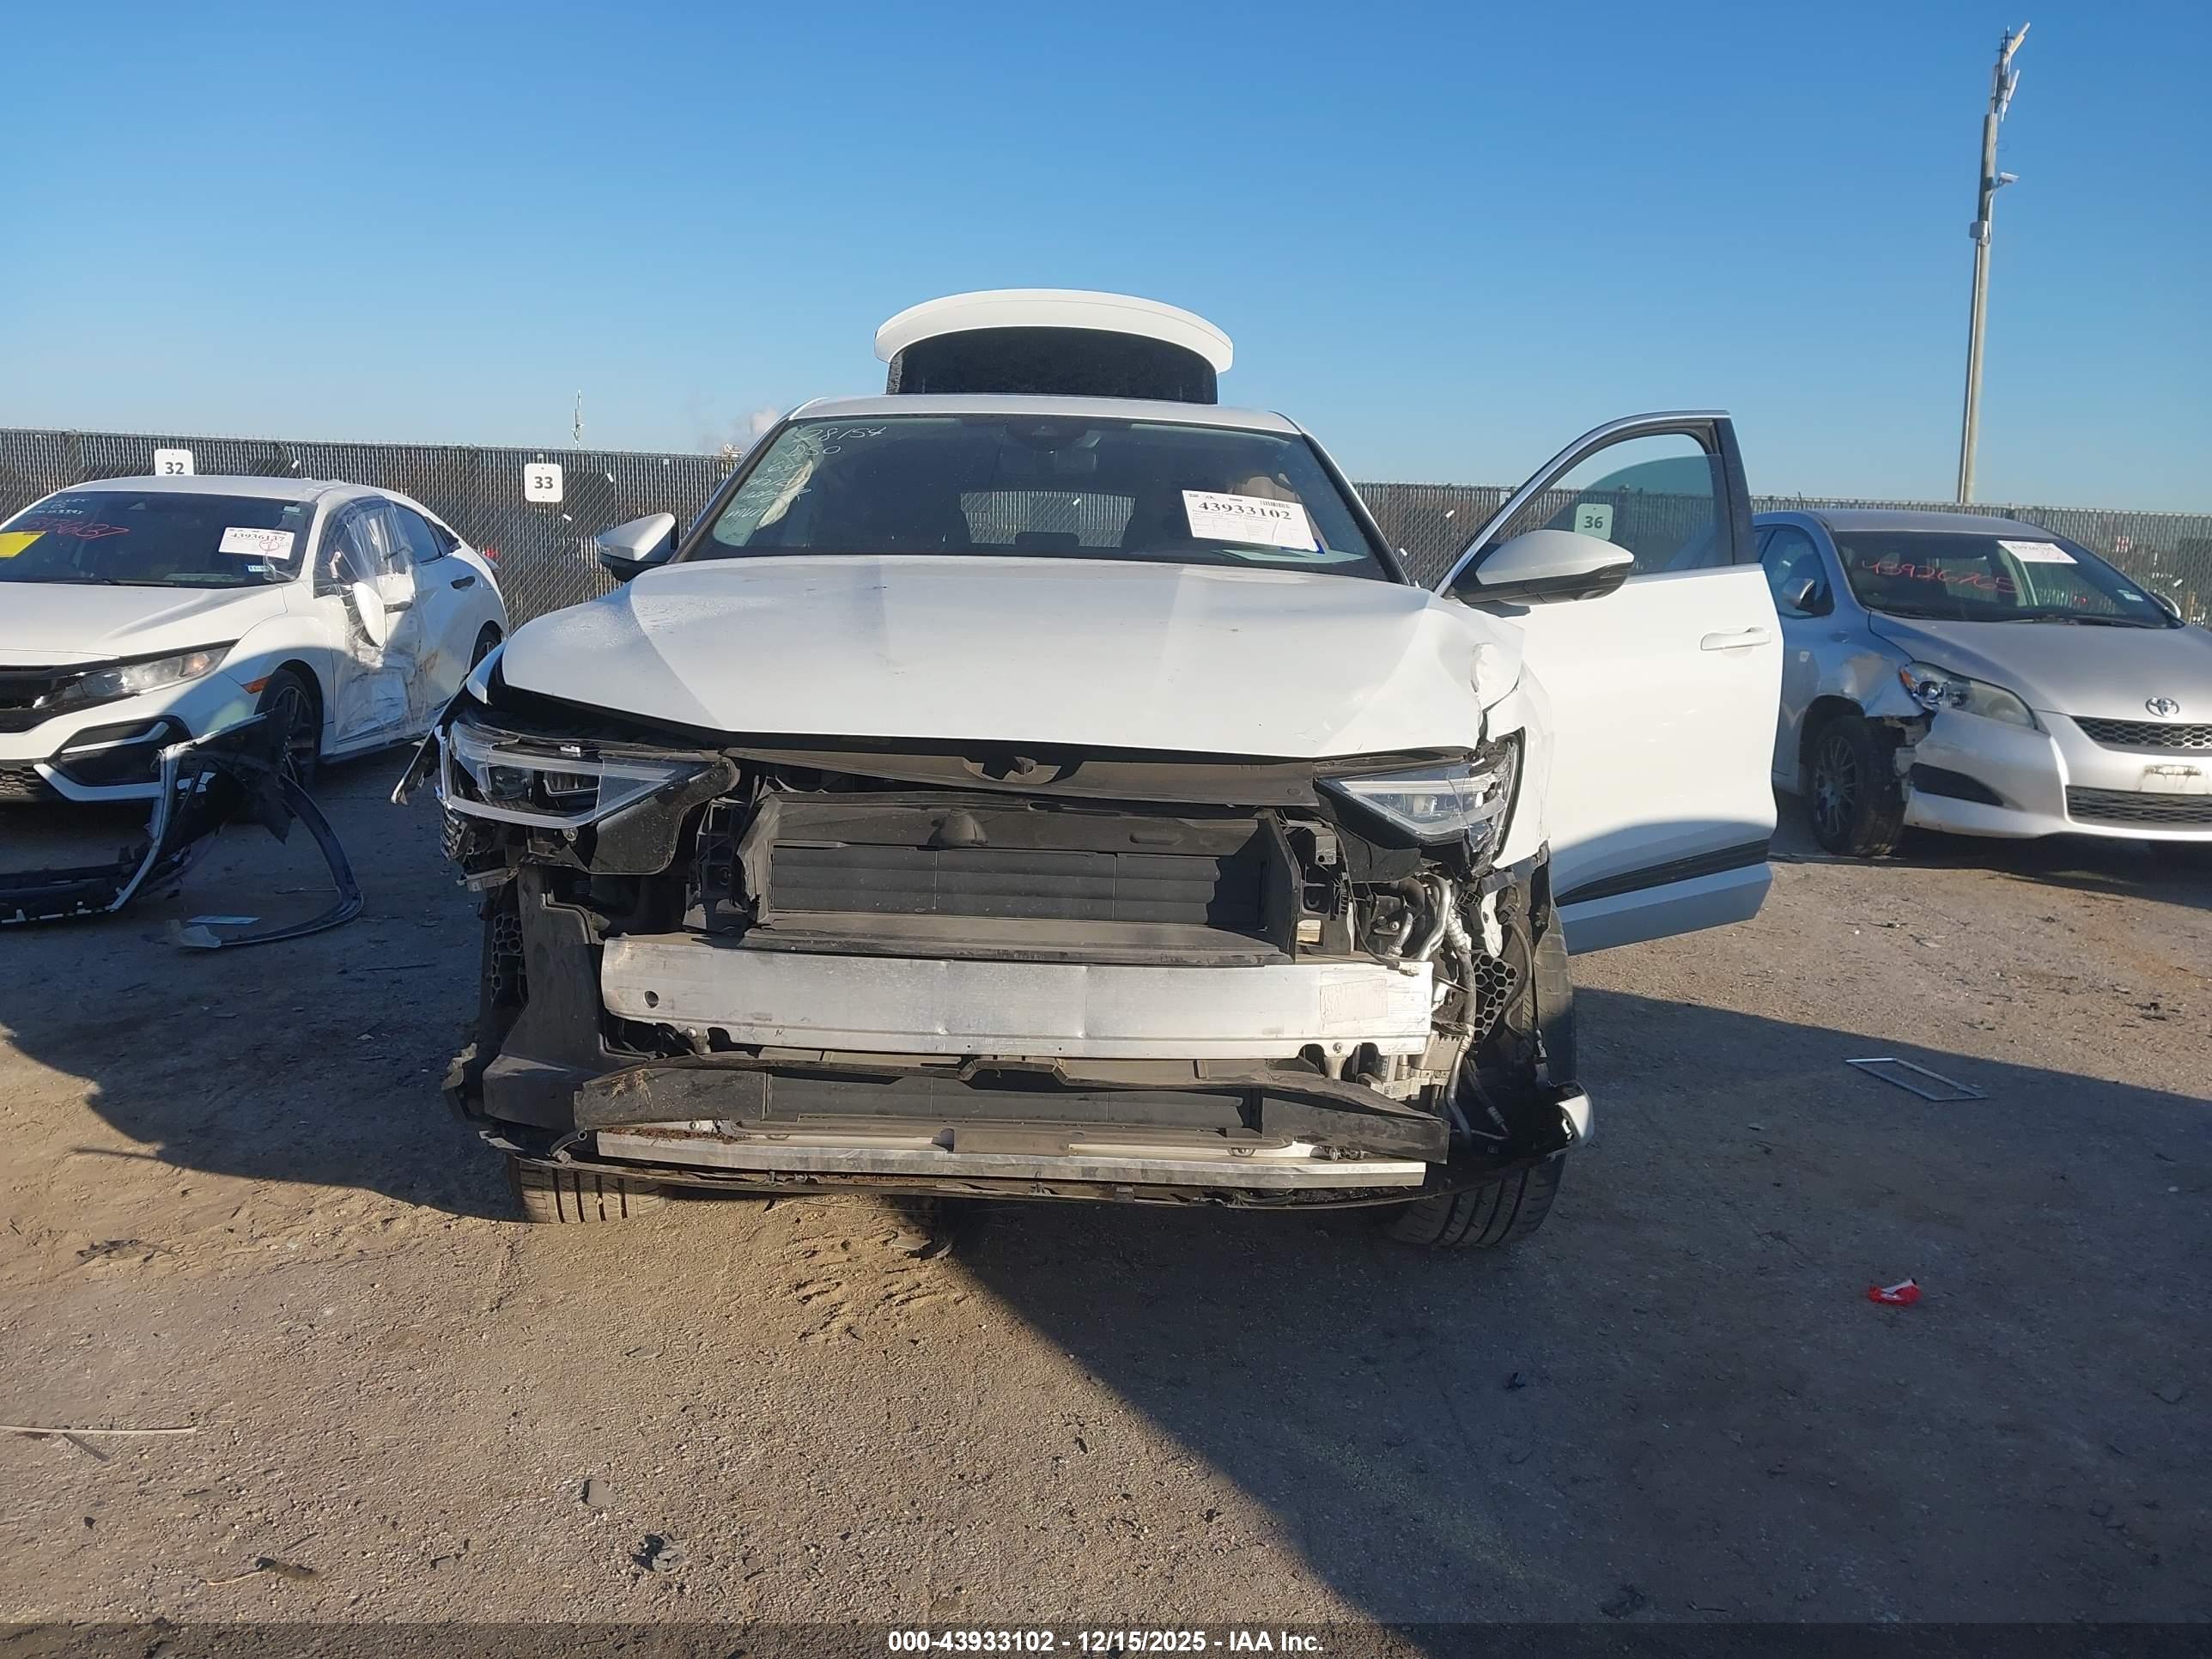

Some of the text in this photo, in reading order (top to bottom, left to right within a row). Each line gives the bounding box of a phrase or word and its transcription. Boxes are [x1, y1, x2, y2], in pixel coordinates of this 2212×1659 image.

[165, 461, 185, 475] 32
[534, 476, 554, 489] 33
[1198, 501, 1292, 520] 43933102
[1583, 515, 1603, 529] 36
